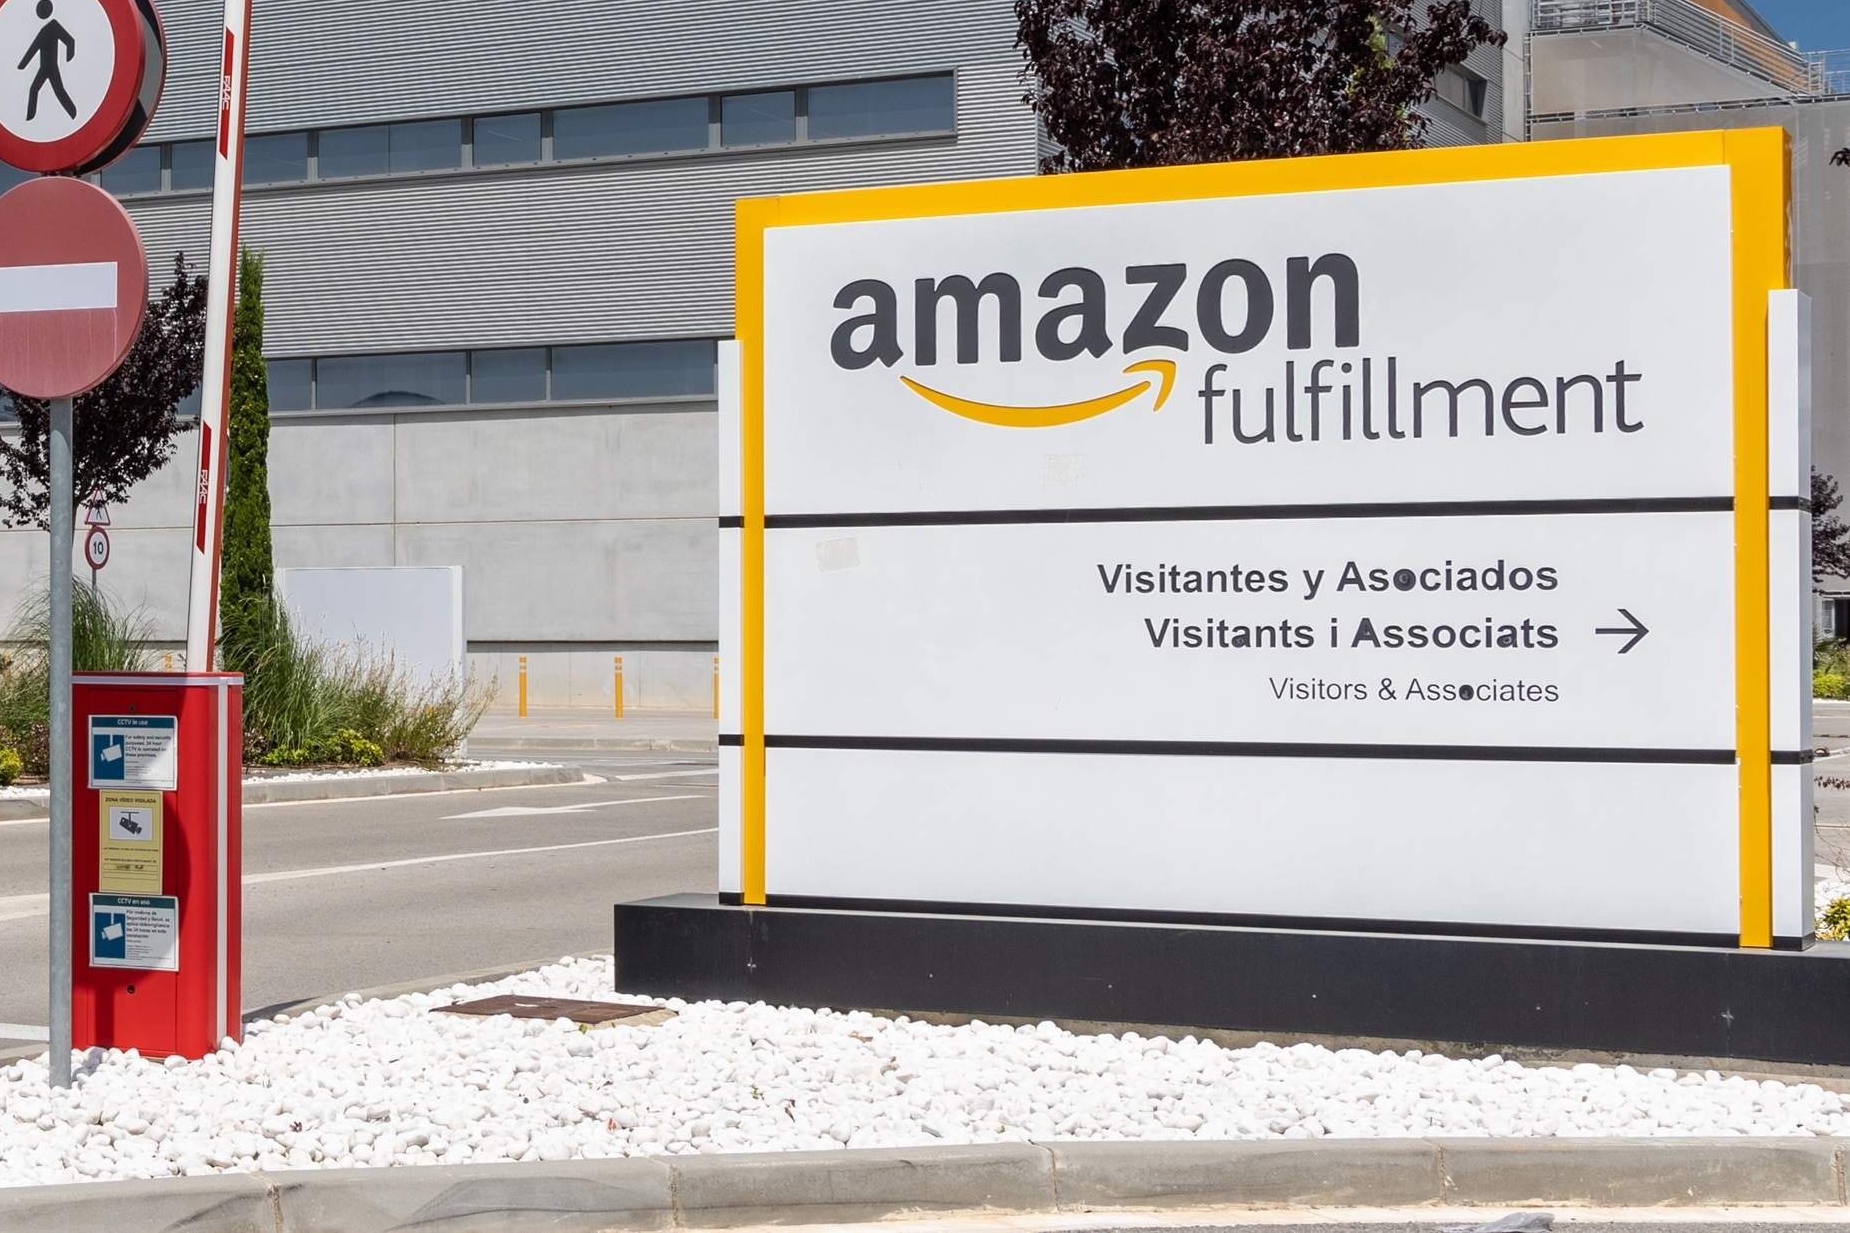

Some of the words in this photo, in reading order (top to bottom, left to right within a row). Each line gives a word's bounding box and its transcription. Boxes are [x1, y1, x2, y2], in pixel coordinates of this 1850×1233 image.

[222, 75, 231, 111] FAAC
[831, 253, 1360, 368] amazon
[1199, 356, 1645, 445] fulfillment
[93, 541, 104, 555] 10
[1098, 563, 1290, 594] Visitantes
[1303, 569, 1326, 602] y
[1336, 560, 1559, 593] Asociados
[1145, 618, 1316, 650] Visitants
[1330, 618, 1339, 649] i
[1351, 618, 1560, 650] Associats
[1270, 678, 1369, 702] Visitors
[1378, 678, 1398, 702] &
[1406, 679, 1560, 703] Associates
